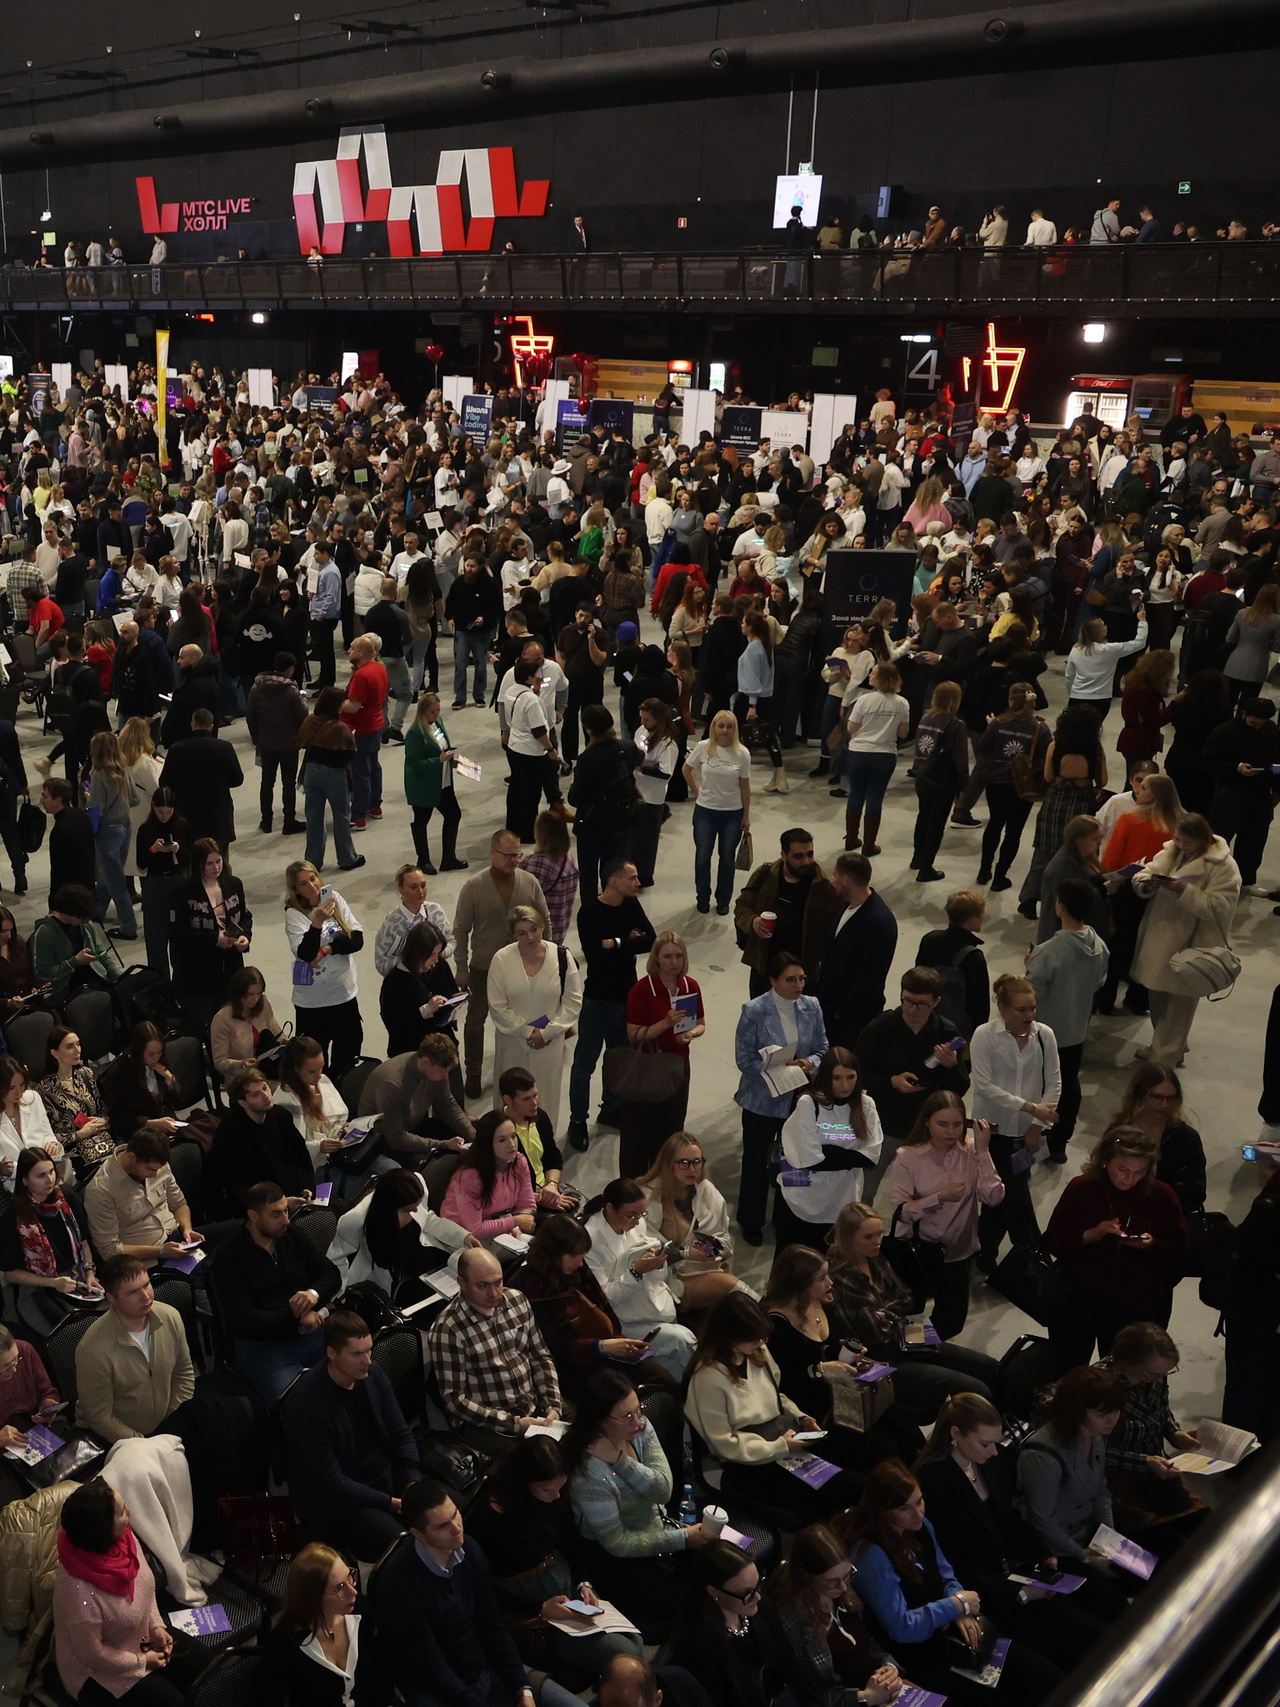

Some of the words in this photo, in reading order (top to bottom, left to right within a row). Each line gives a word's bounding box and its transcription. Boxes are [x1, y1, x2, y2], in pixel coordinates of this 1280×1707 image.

[182, 200, 216, 217] МТС
[217, 198, 251, 215] LIVE
[183, 215, 228, 232] ХОЛЛ
[908, 349, 942, 391] 4
[465, 405, 489, 414] Школа
[465, 413, 481, 421] Vibe
[464, 420, 487, 431] coding
[831, 614, 849, 622] Зона
